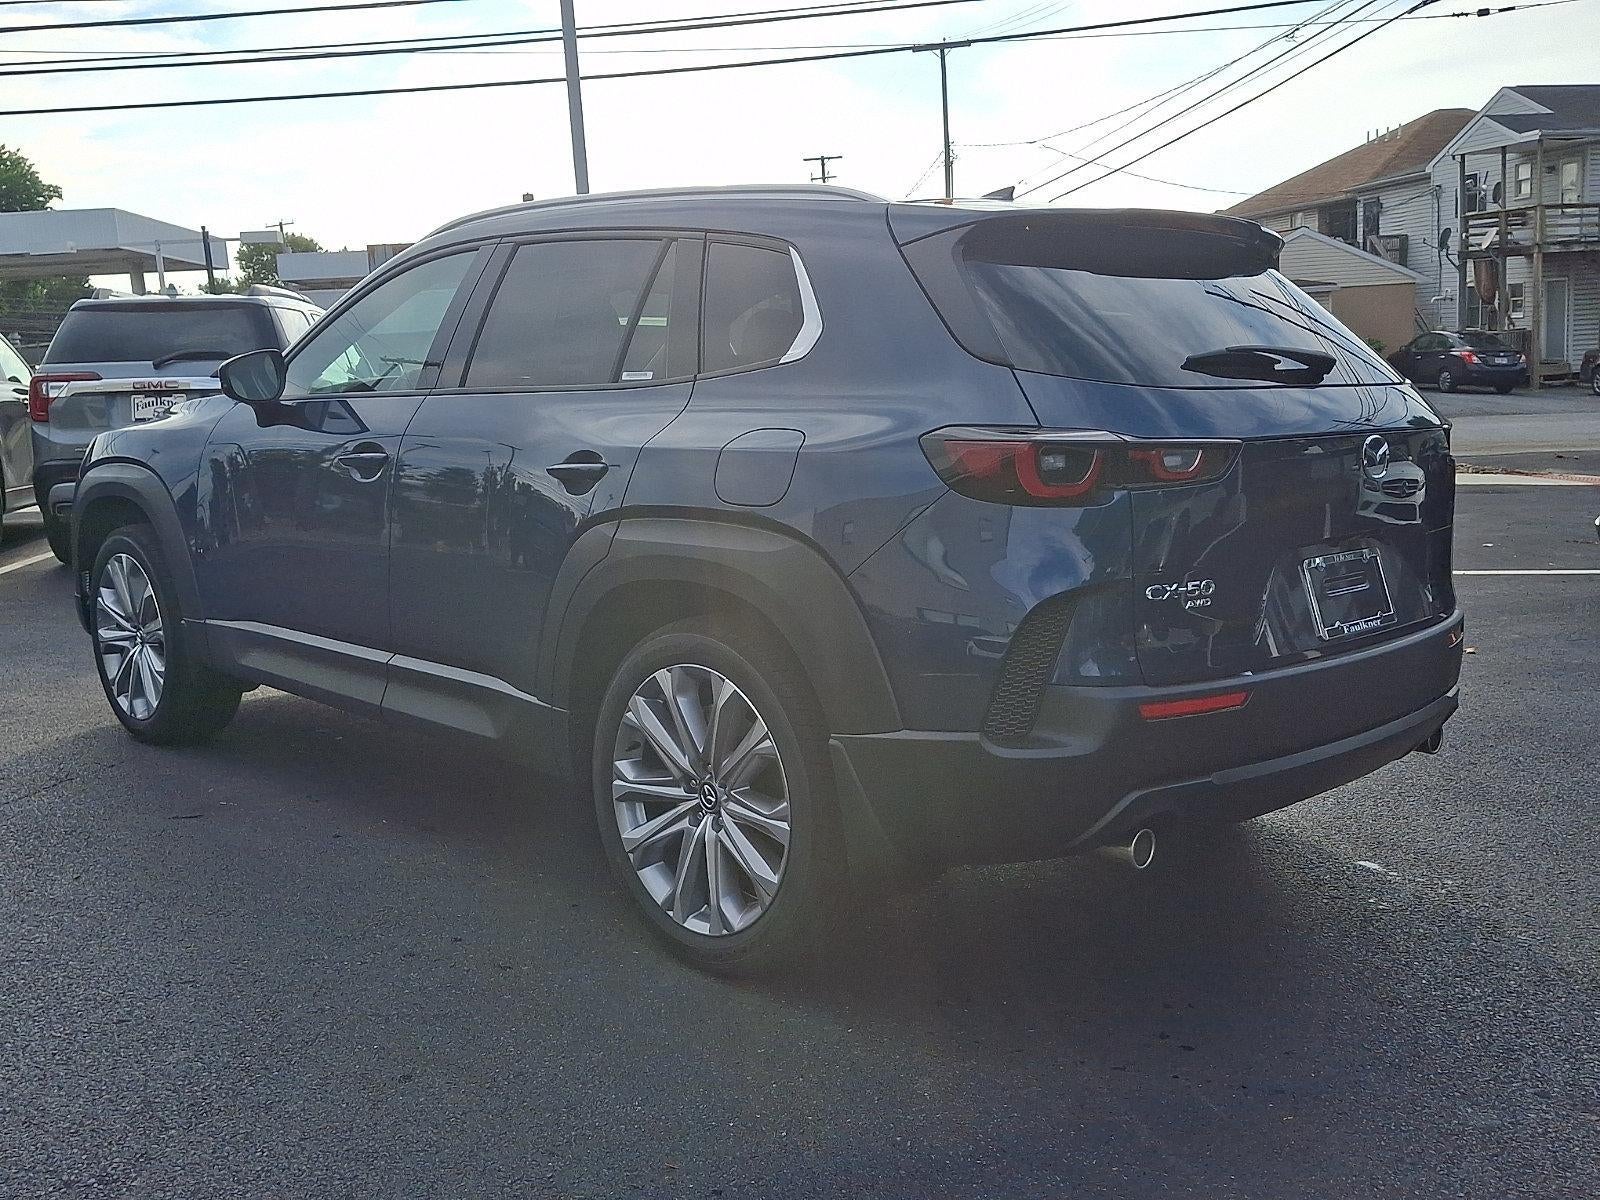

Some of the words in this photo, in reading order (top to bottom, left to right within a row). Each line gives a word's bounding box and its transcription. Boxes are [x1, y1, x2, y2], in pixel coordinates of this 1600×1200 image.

[132, 380, 180, 390] GMC
[135, 396, 178, 412] Faulkn
[1145, 579, 1216, 600] CX-50
[1185, 598, 1212, 610] AWD
[1343, 619, 1381, 634] Faulkner
